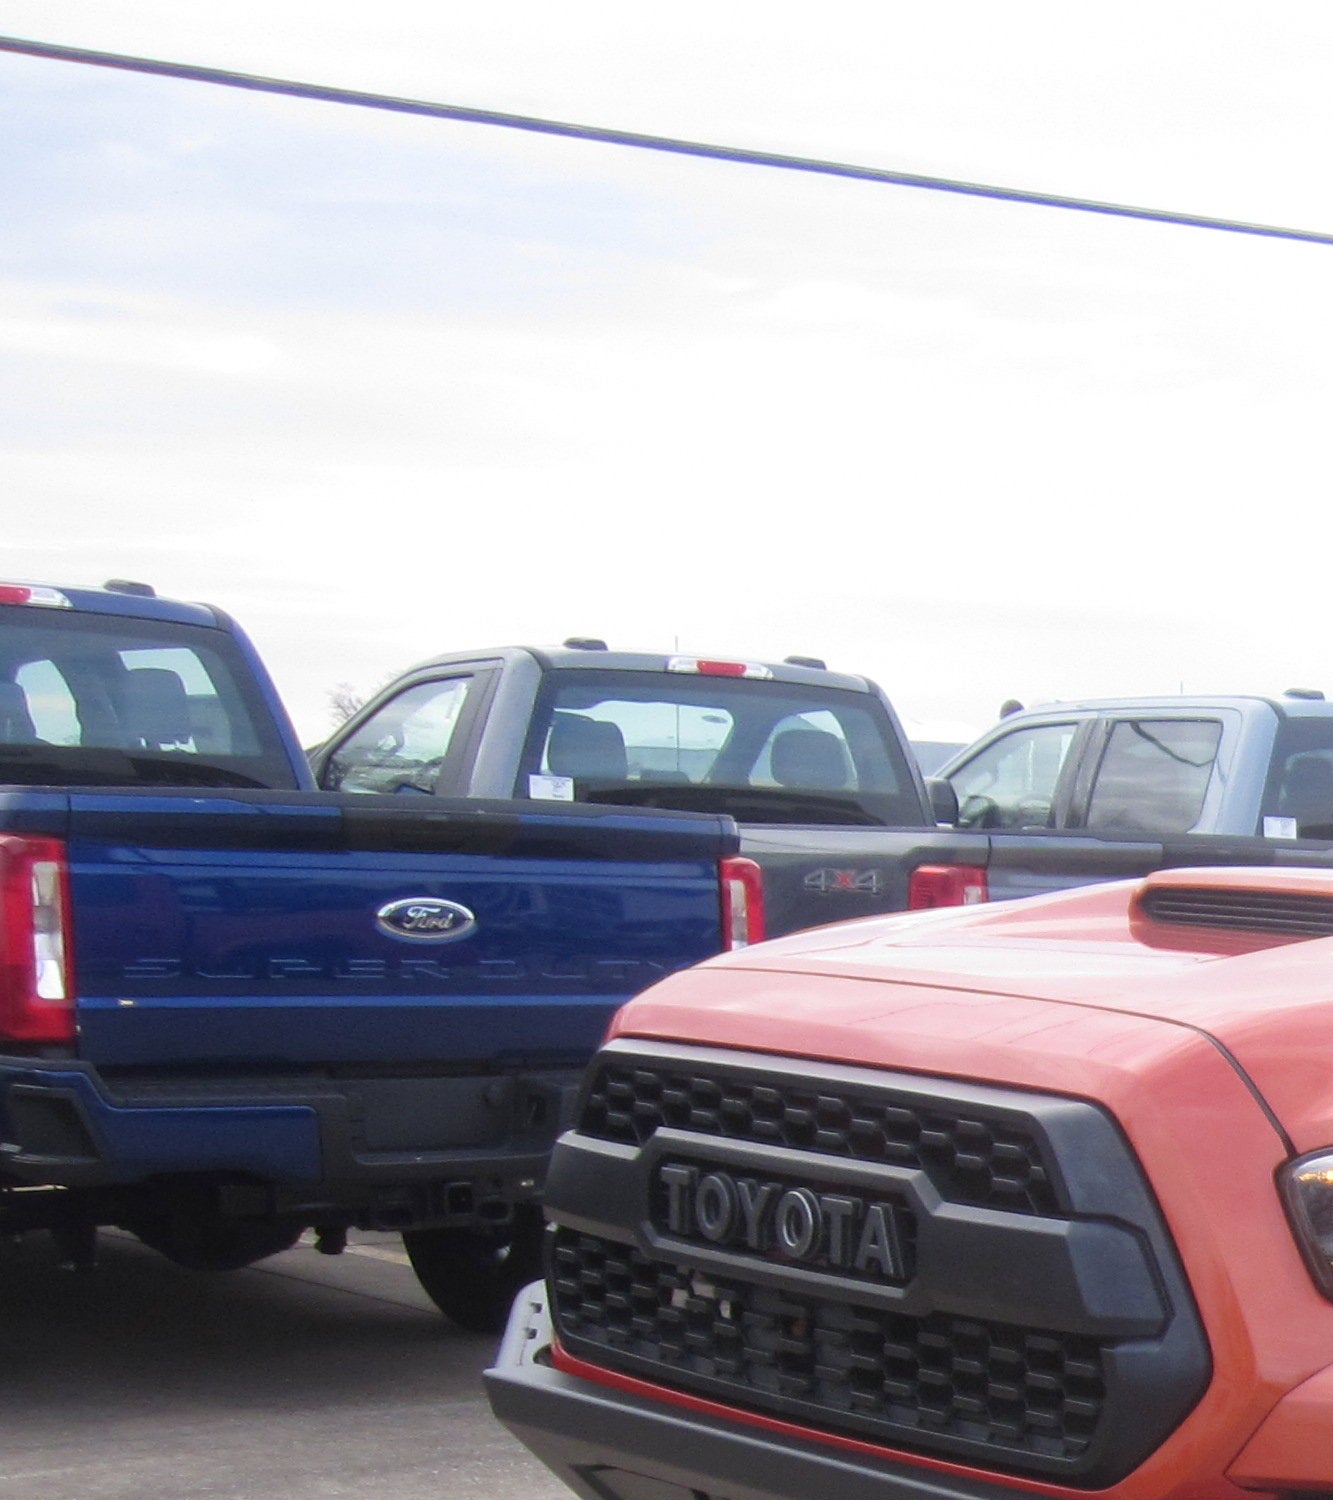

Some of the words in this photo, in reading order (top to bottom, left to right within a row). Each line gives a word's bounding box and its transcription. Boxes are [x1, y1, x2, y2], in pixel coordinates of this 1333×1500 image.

[402, 905, 453, 930] Ford
[123, 958, 451, 980] SUPER
[660, 1162, 906, 1280] TOYOTA
